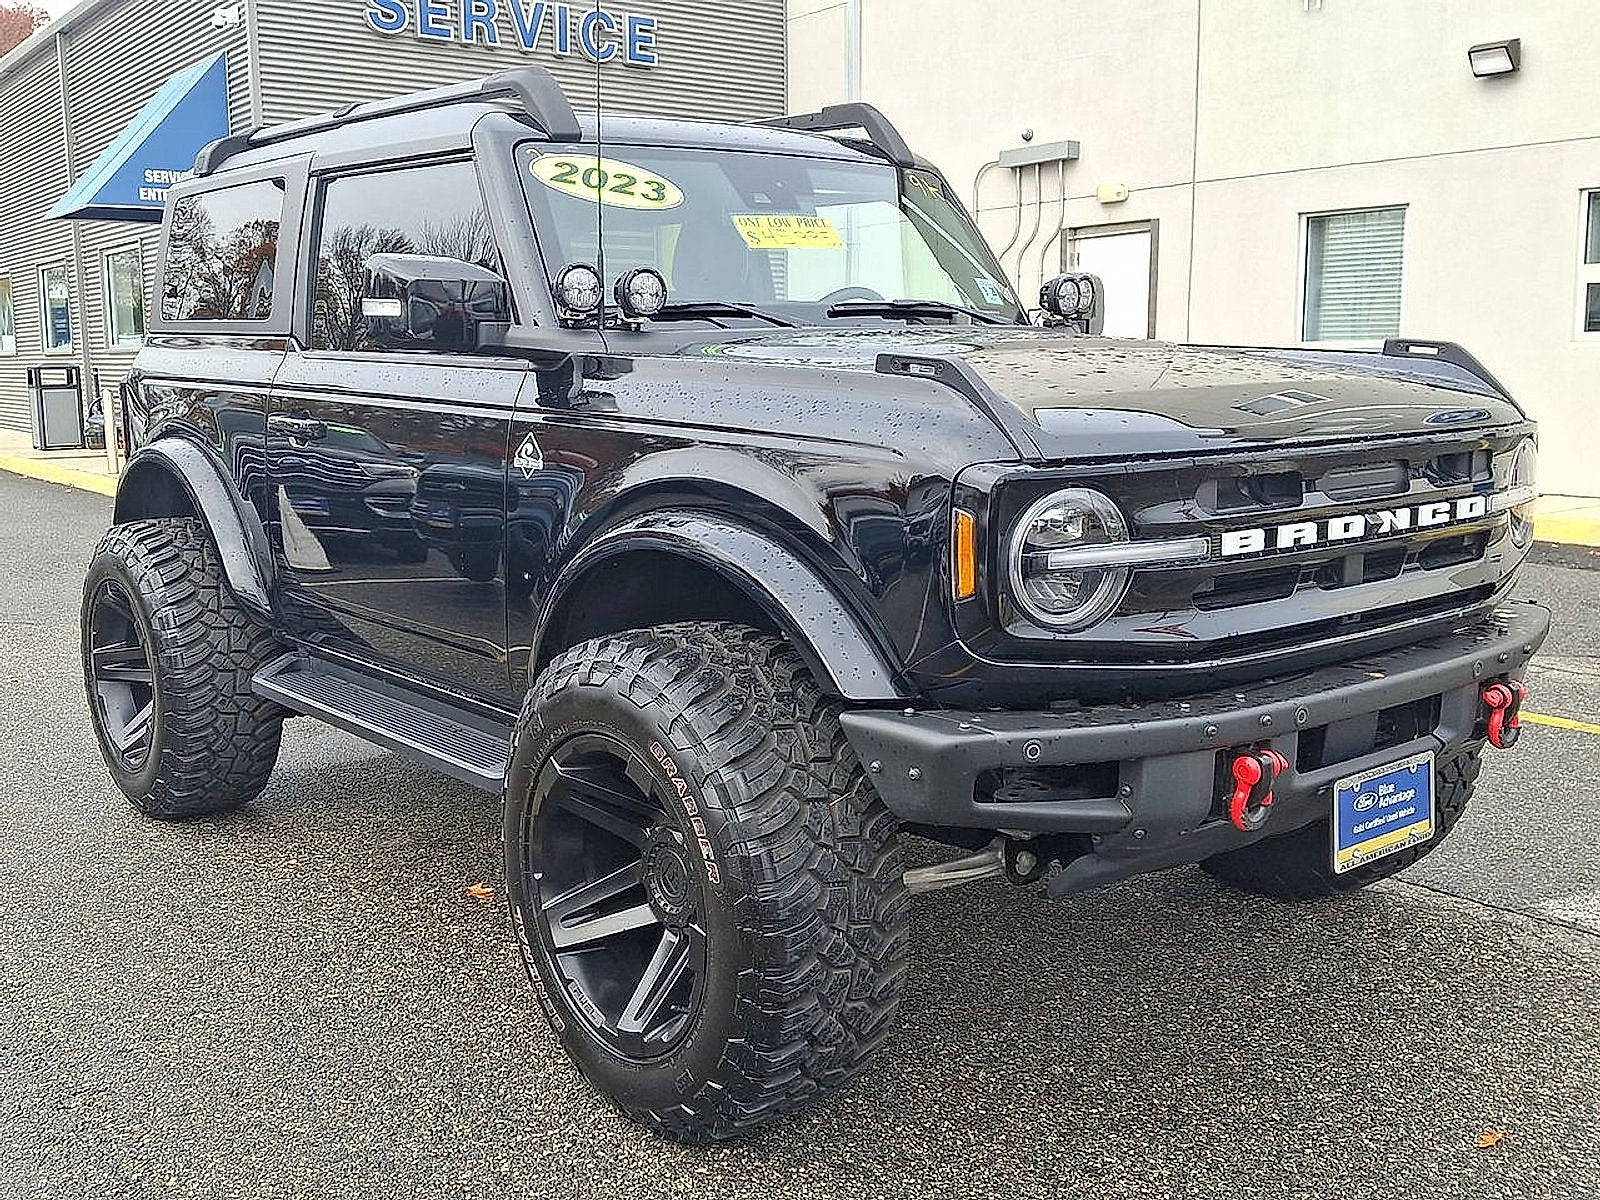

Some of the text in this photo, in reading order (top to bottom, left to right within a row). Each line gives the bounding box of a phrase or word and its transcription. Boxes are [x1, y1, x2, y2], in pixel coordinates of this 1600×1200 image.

[366, 0, 659, 66] SERVICE
[550, 161, 667, 202] 2023
[738, 217, 832, 228] ONE LOW PRICE
[1221, 494, 1486, 557] BRONCO
[1378, 783, 1396, 797] Blue
[1378, 788, 1416, 809] Advantage
[650, 741, 720, 884] GRABBER
[1365, 817, 1386, 829] Certified
[1386, 811, 1399, 823] Used
[1399, 807, 1416, 818] Vehicle
[1360, 840, 1408, 864] AMERICAN
